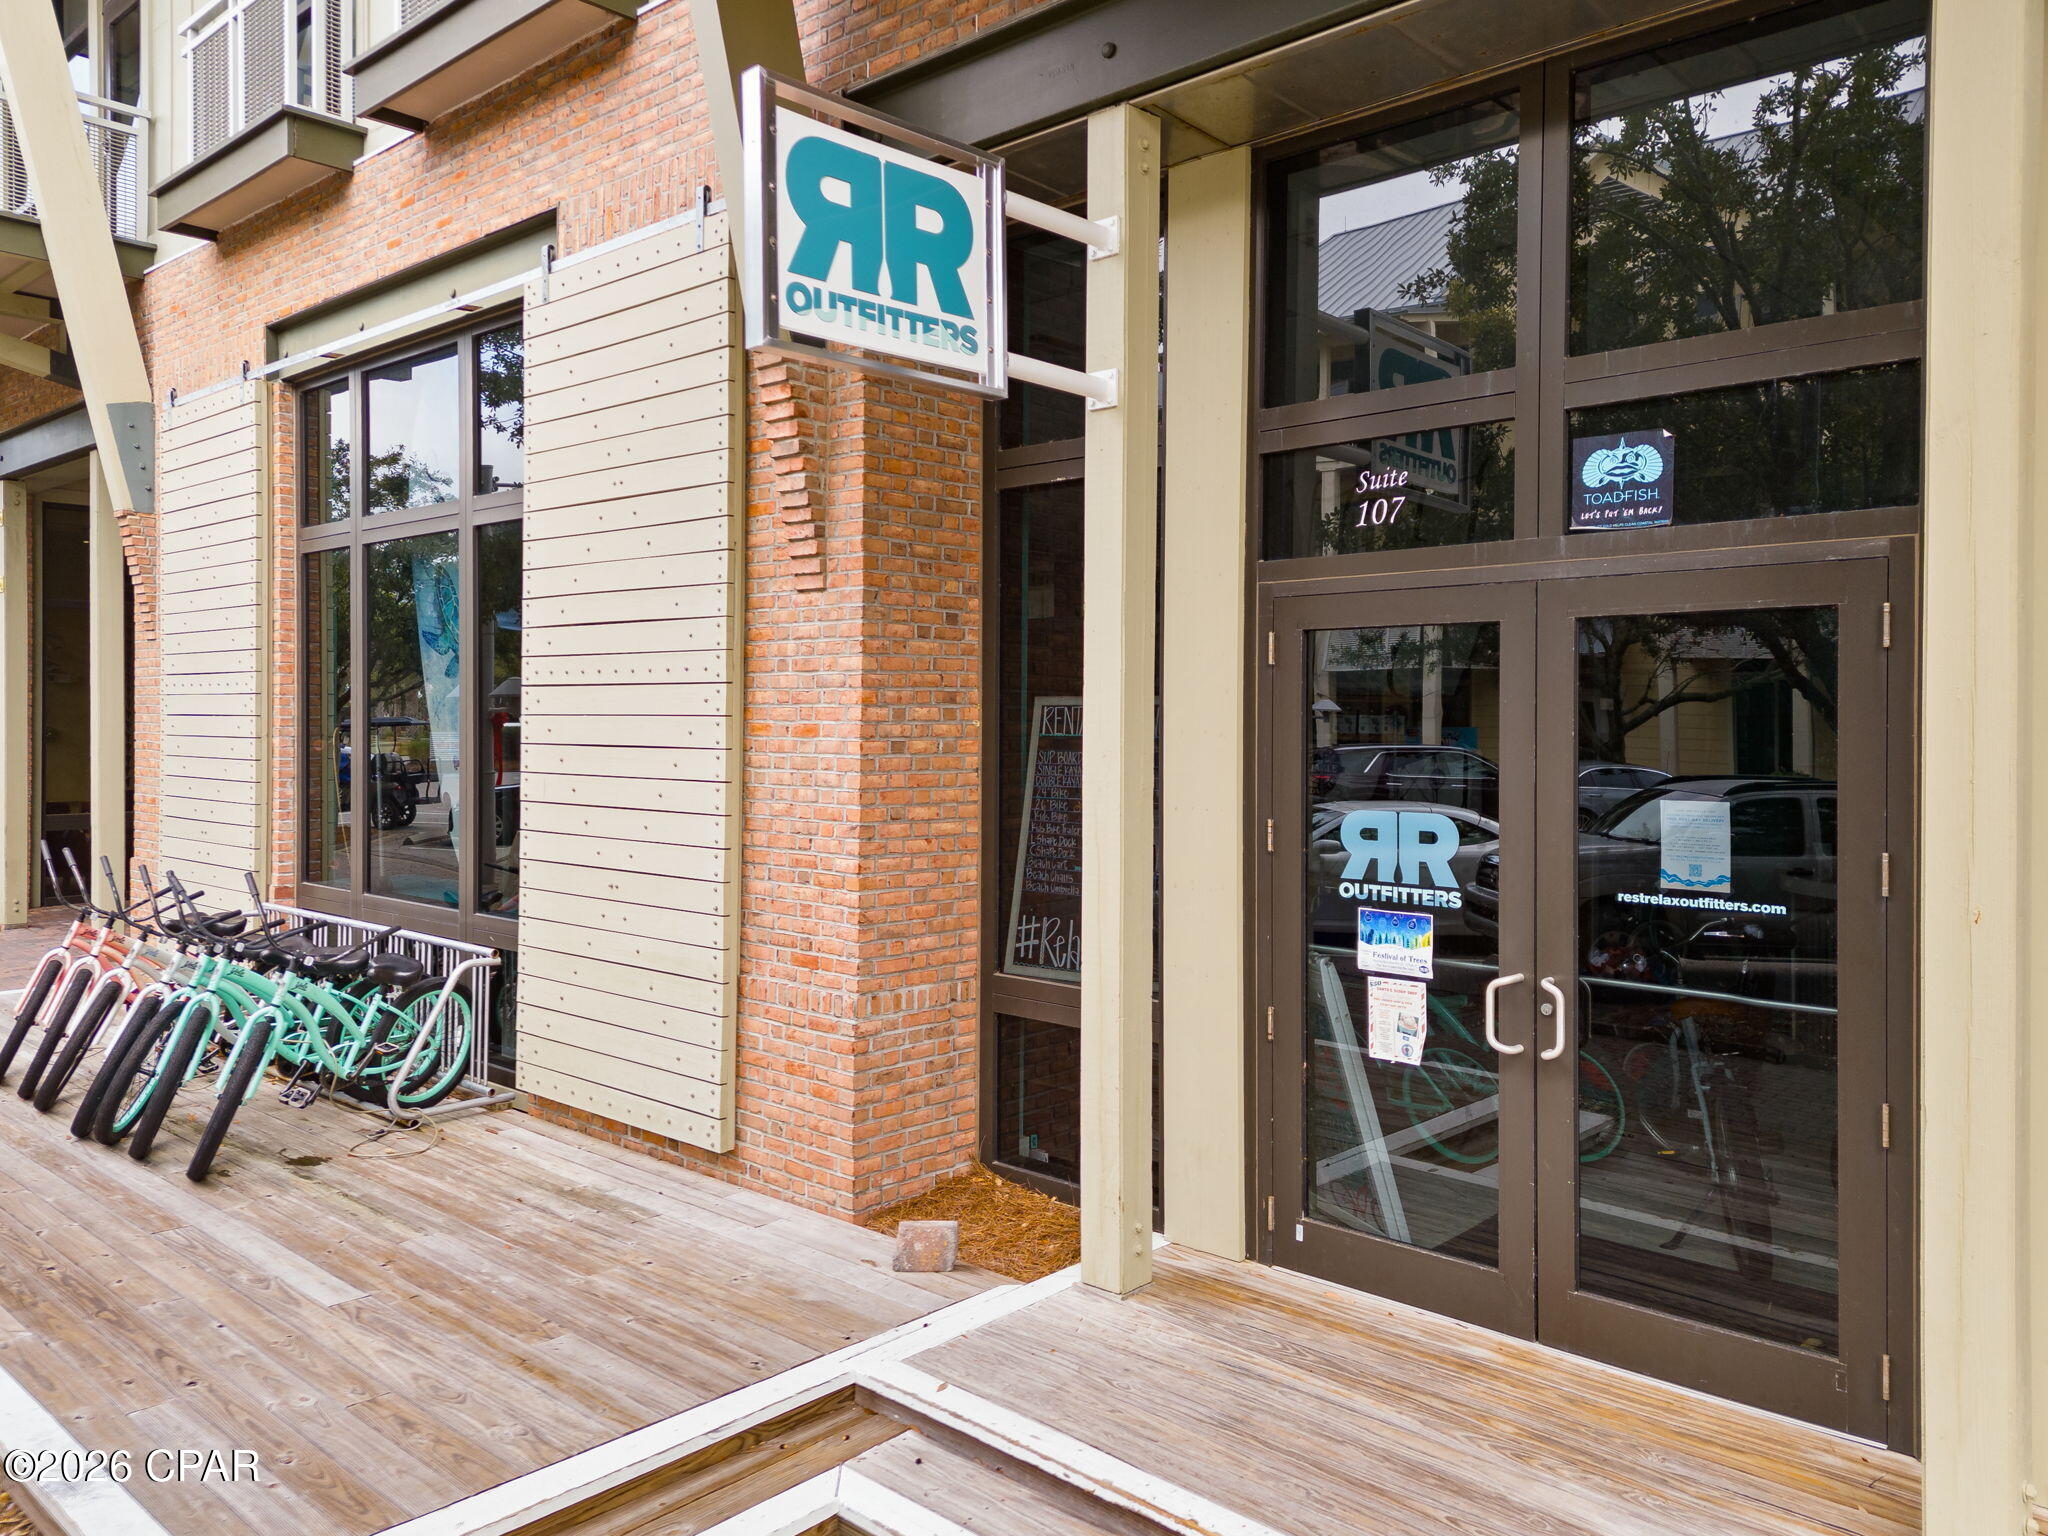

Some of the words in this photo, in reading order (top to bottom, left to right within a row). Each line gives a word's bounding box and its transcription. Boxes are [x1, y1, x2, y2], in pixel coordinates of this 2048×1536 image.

[785, 281, 979, 356] OUTFITTERS
[1355, 466, 1409, 494] Suite
[1583, 488, 1660, 506] TOADFISH
[1355, 496, 1406, 528] 107
[1581, 509, 1601, 520] LET'S
[1605, 509, 1619, 518] PUT
[1622, 507, 1634, 517] 'EM
[1638, 505, 1663, 516] BACK!
[1338, 881, 1463, 909] OUTFITTERS
[1616, 892, 1788, 915] restrelaxoutfitters.com
[1372, 951, 1399, 961] Festival
[1408, 955, 1428, 964] Trees
